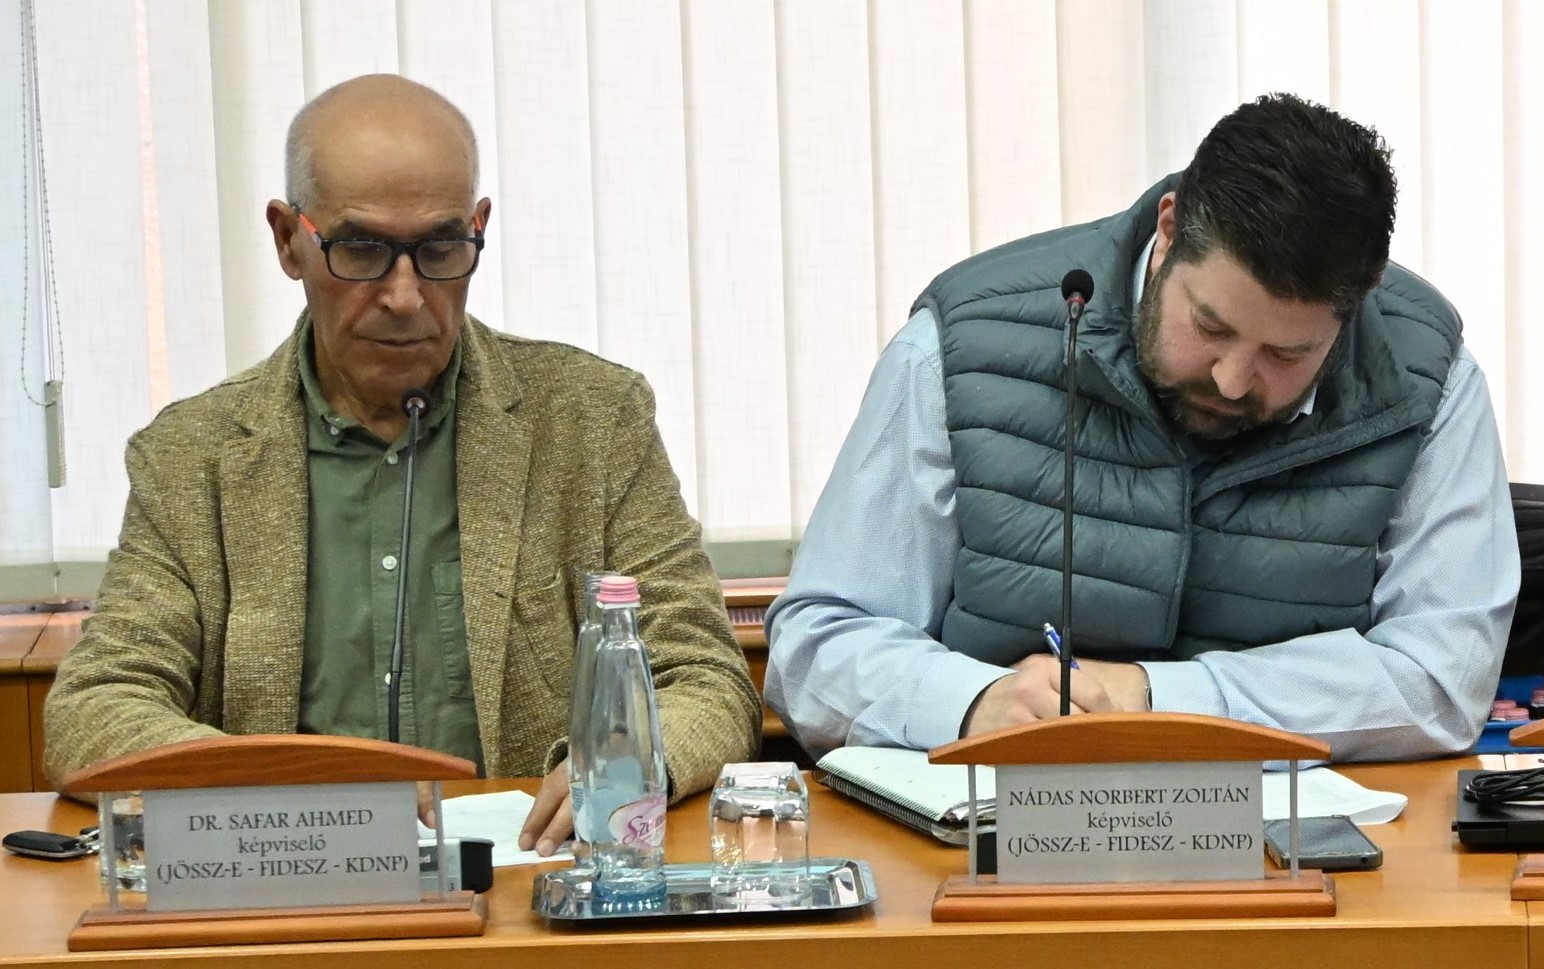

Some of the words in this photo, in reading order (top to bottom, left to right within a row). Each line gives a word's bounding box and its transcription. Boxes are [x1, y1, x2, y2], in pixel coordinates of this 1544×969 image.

[1008, 786, 1074, 807] NÁDAS
[1079, 788, 1168, 806] NORBERT
[1172, 783, 1250, 804] ZOLTÁN
[188, 814, 223, 832] DR.
[228, 812, 290, 831] SAFAR
[295, 809, 374, 828] AHMED
[1087, 810, 1173, 833] képviselő
[238, 833, 327, 858] képviselő
[1007, 833, 1091, 858] (JÖSSZ-E
[1106, 834, 1175, 852] FIDESZ
[1191, 833, 1253, 851] KDNP)
[156, 860, 243, 885] (JÖSSZ-E
[259, 858, 329, 877] FIDESZ
[345, 855, 409, 874] KDNP)
